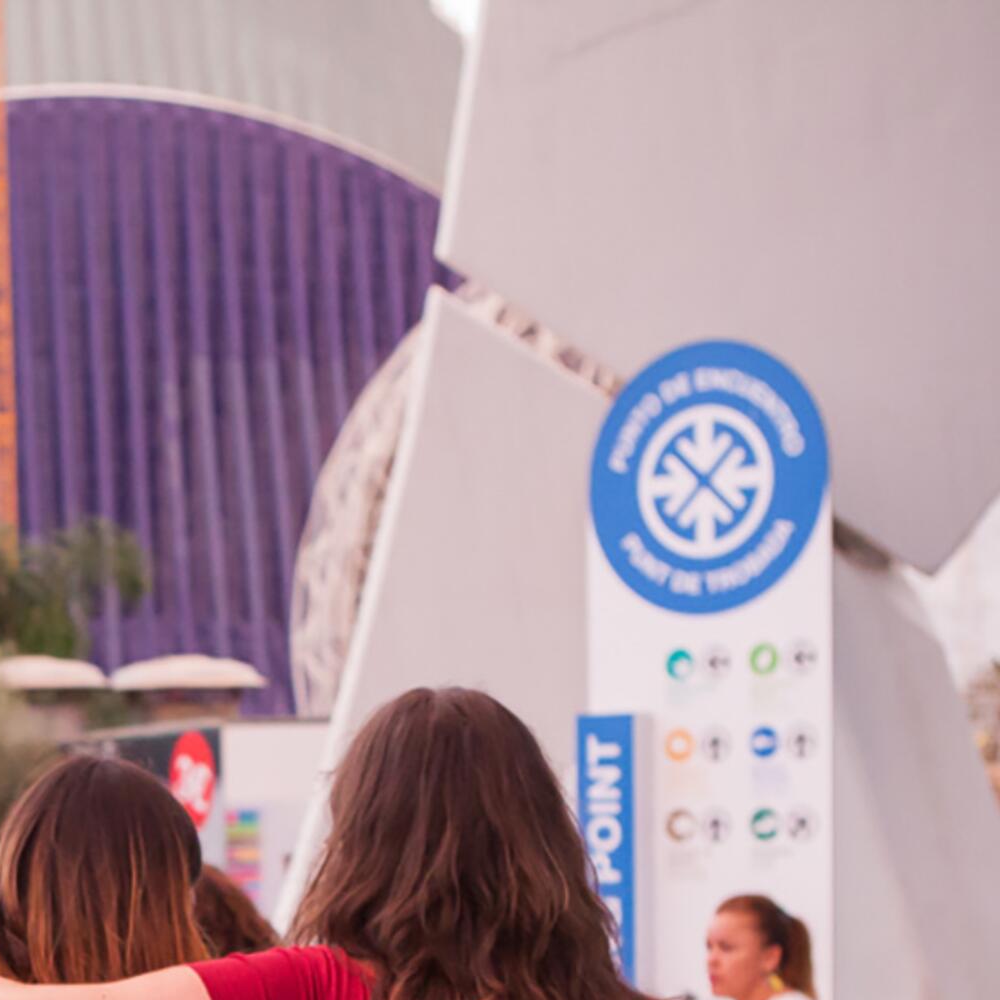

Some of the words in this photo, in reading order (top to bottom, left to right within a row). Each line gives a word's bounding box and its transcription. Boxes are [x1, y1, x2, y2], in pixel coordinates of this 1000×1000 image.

[608, 392, 662, 474] PUNTO
[658, 371, 692, 405] DE
[668, 567, 702, 596] DE
[586, 732, 623, 884] POINT
